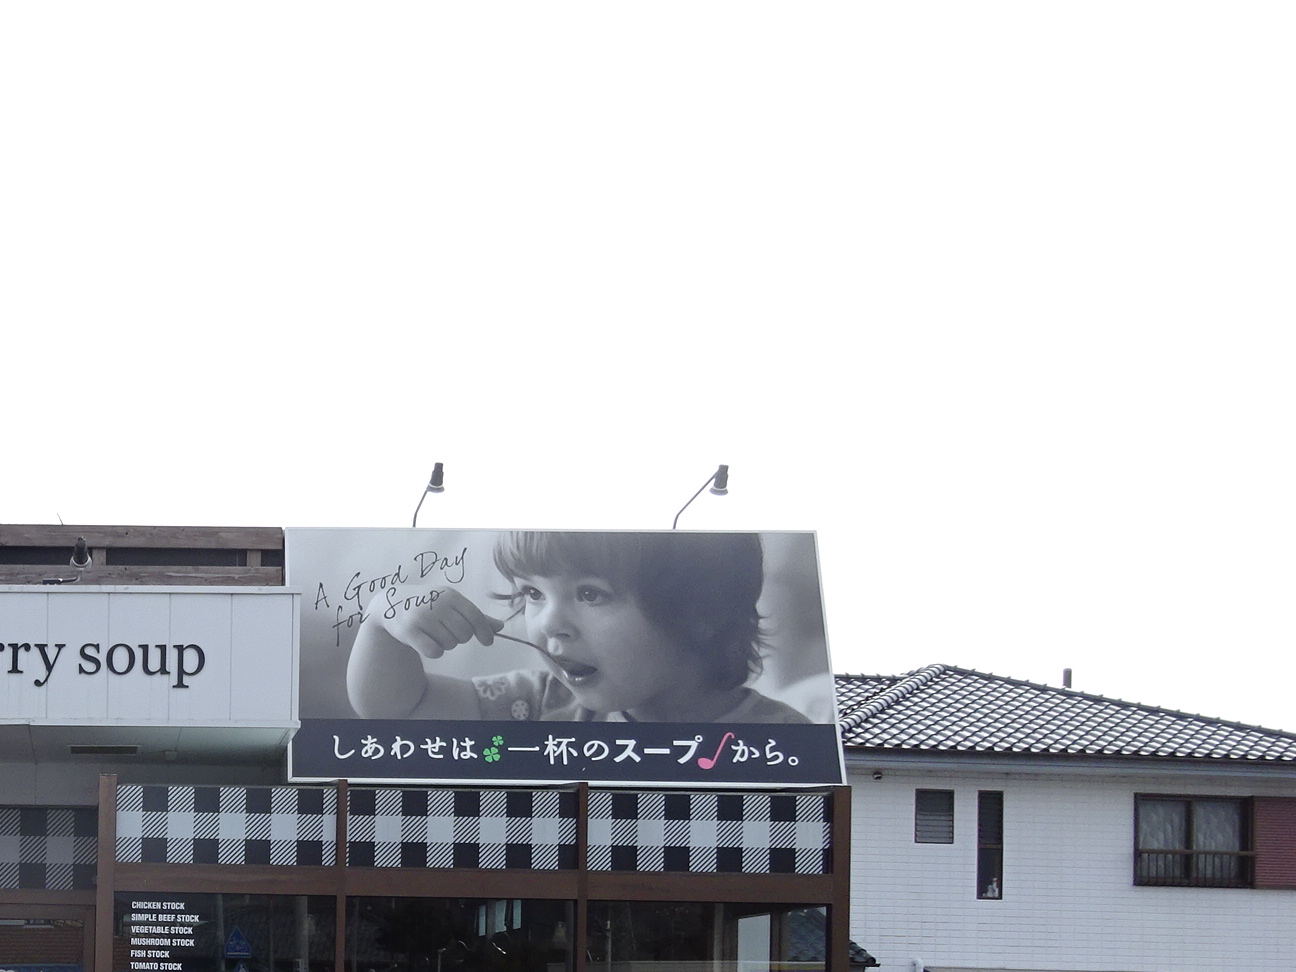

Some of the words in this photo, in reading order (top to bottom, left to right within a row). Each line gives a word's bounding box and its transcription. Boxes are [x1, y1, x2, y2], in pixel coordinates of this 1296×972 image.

[314, 582, 328, 610] A
[344, 564, 409, 603] Good
[413, 546, 467, 584] Day
[383, 587, 446, 620] Soup
[77, 641, 206, 688] soup
[132, 901, 161, 909] CHICKEN
[162, 901, 184, 910] STOCK
[158, 914, 175, 922] BEEF
[131, 926, 169, 934] VEGETABLE
[170, 926, 193, 934] STOCK
[131, 938, 170, 946] MUSHROOM
[131, 950, 146, 958] FISH
[147, 950, 169, 958] STOCK
[131, 962, 158, 970] TOMATO
